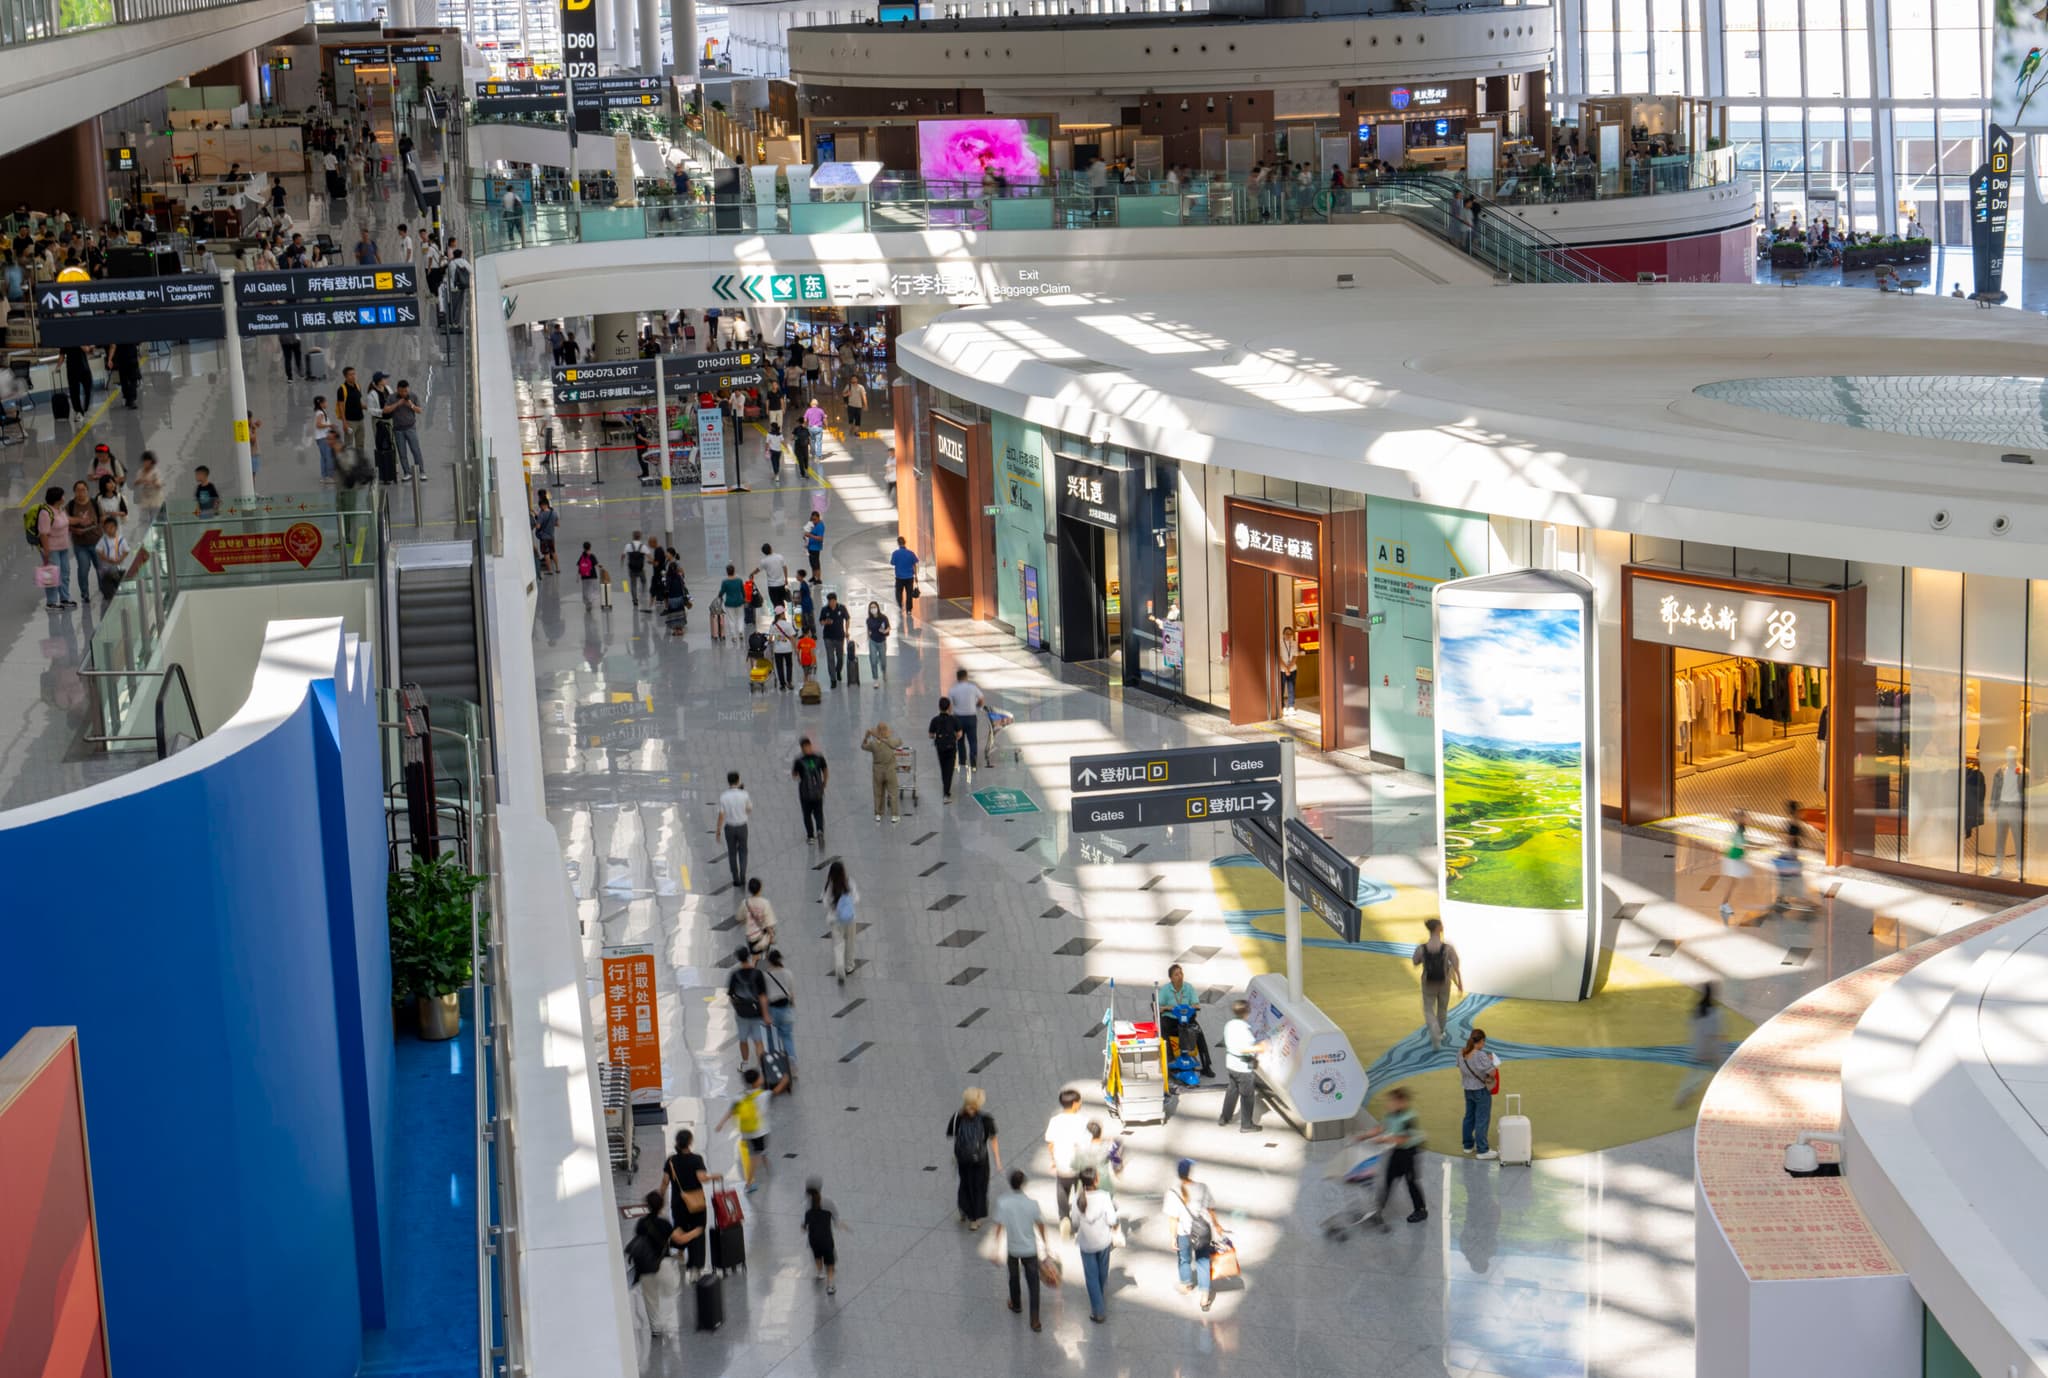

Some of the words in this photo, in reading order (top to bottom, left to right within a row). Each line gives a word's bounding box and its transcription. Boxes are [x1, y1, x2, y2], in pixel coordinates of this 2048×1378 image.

[568, 33, 595, 48] D60
[569, 62, 596, 78] D73
[1996, 157, 2005, 169] D
[1992, 179, 2008, 190] D60
[1992, 198, 2007, 210] D73
[1019, 270, 1039, 280] Exit
[167, 285, 187, 293] China
[188, 283, 215, 292] Eastern
[244, 284, 256, 293] All
[258, 282, 287, 292] Gates
[308, 276, 374, 291] 所有登机口
[805, 276, 821, 290] 东
[994, 286, 1039, 297] Baggage
[1040, 283, 1071, 294] Claim
[171, 293, 197, 302] Lounge
[198, 292, 212, 300] P11
[257, 313, 278, 322] Shops
[302, 311, 357, 326] 商店、餐饮
[248, 321, 288, 331] Restaurants
[697, 357, 741, 369] D110-D115
[616, 366, 638, 376] D61T
[938, 434, 964, 463] DAZZLE
[1067, 475, 1104, 504] 兴礼遇
[1378, 544, 1388, 560] A
[1395, 547, 1405, 564] B
[1660, 595, 1738, 641] 鄂尔多斯
[1231, 760, 1264, 771] Gates
[1100, 765, 1146, 783] 登机口
[1153, 766, 1163, 777] D
[1192, 802, 1202, 813] C
[1209, 796, 1254, 814] 登机口
[1091, 811, 1124, 822] Gates
[634, 961, 649, 1004] 提取处
[607, 963, 631, 1063] 行李手推车
